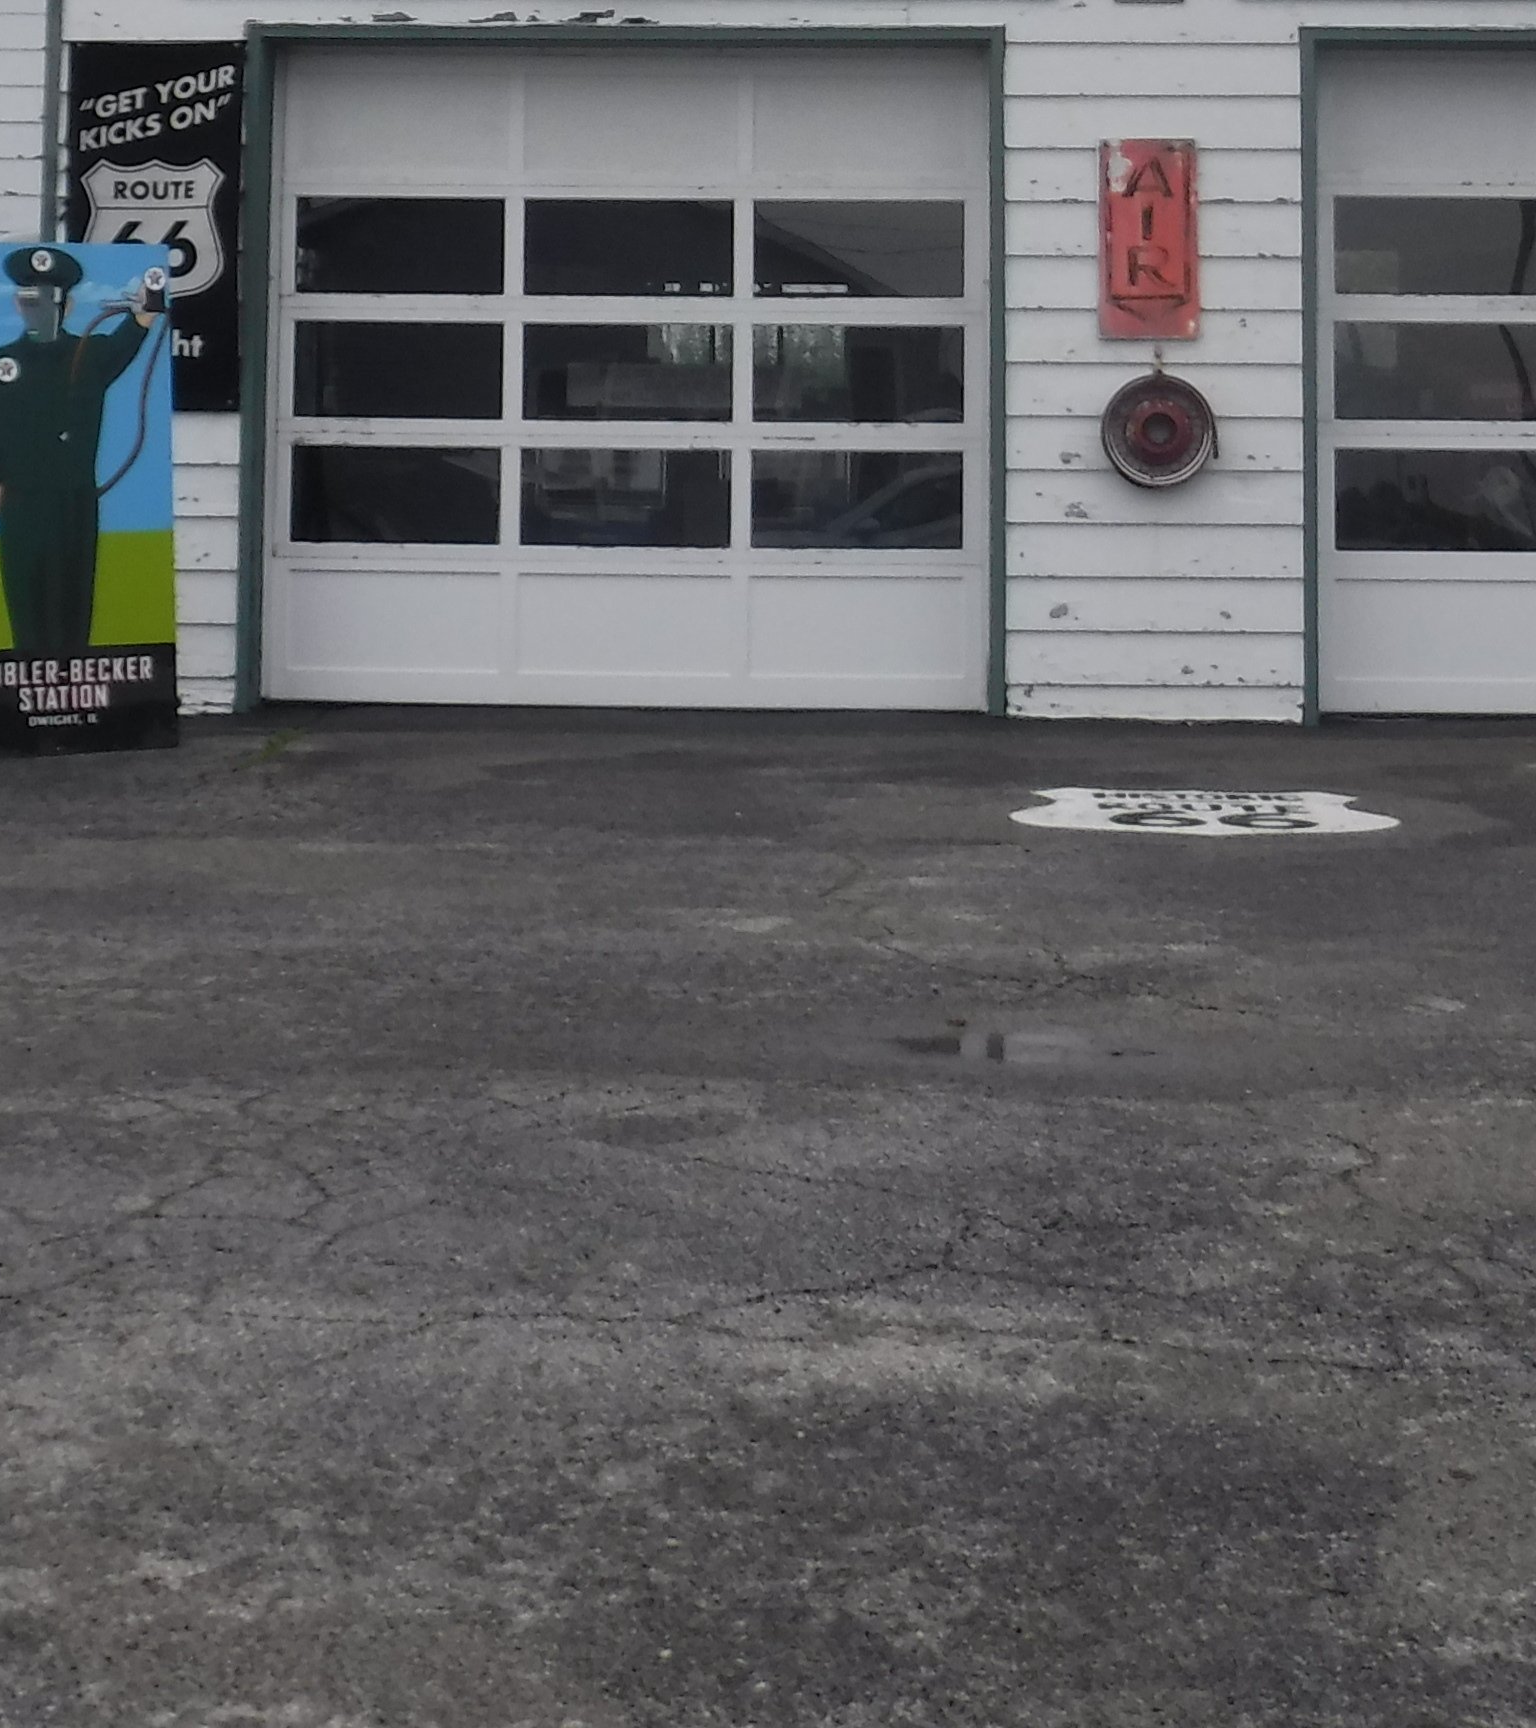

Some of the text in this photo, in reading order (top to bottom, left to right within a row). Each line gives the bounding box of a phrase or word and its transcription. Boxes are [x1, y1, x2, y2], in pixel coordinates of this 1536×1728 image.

[154, 64, 235, 104] YOUR
[79, 113, 163, 152] KICKS
[113, 180, 195, 201] ROUTE
[1122, 157, 1175, 287] AIR
[19, 684, 108, 712] STATION
[1109, 810, 1320, 830] 66
